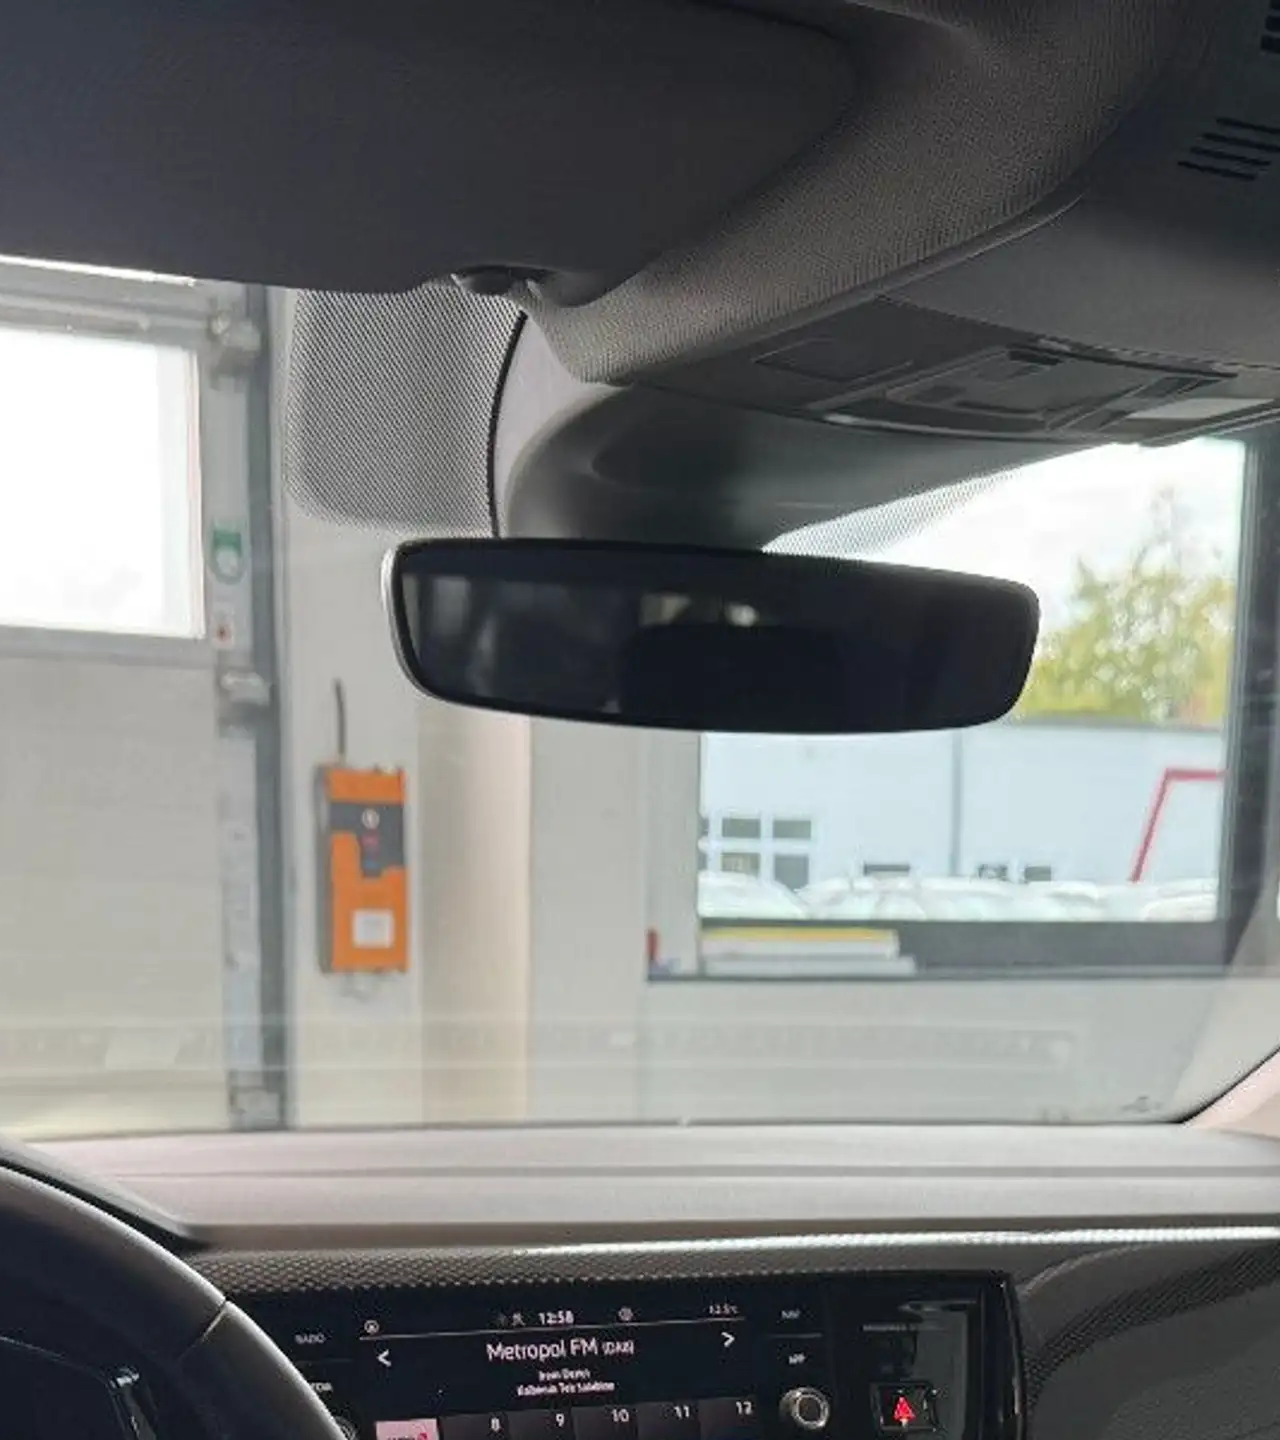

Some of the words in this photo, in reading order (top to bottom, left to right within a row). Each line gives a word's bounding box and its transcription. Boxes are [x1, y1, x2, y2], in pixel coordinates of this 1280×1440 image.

[486, 1340, 567, 1362] Metropol
[569, 1337, 598, 1356] FM
[611, 1408, 630, 1423] 10
[673, 1406, 690, 1420] 11
[735, 1401, 753, 1416] 12
[490, 1417, 501, 1432] 8
[555, 1412, 566, 1428] 9
